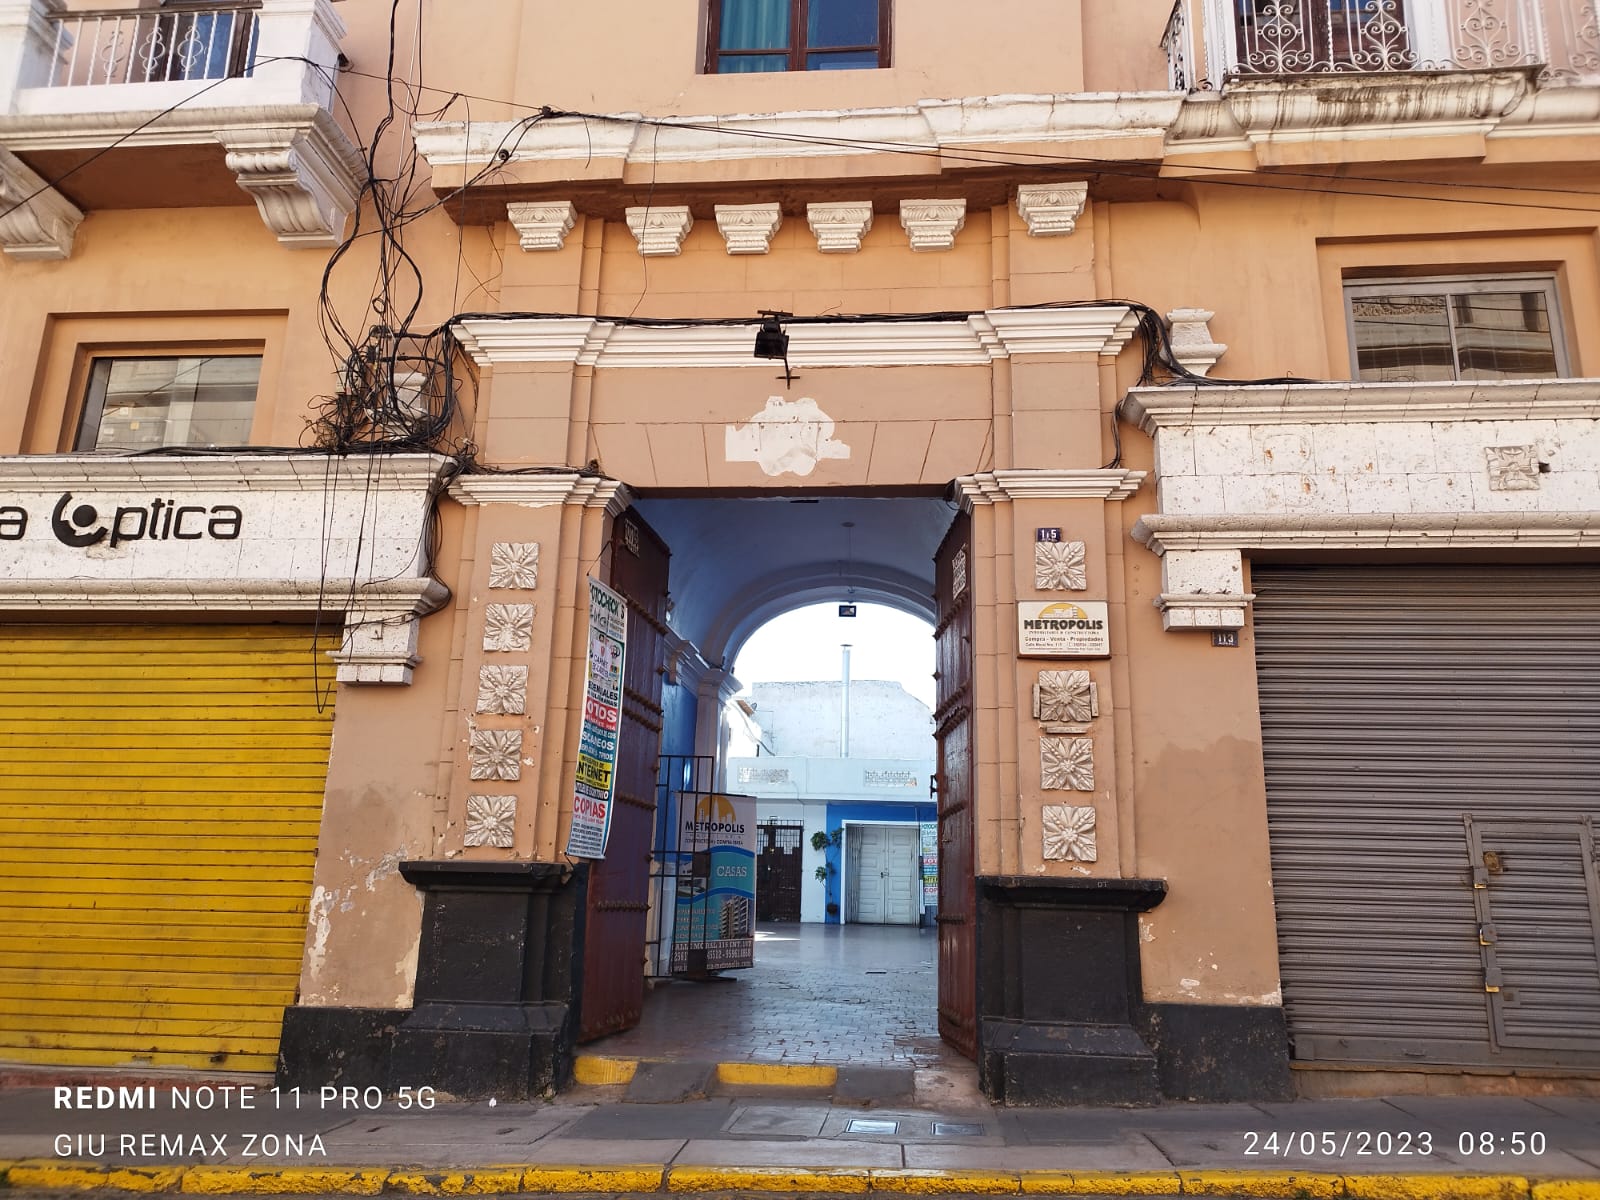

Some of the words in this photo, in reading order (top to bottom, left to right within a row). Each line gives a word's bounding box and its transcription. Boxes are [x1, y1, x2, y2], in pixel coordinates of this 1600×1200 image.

[1024, 619, 1103, 630] METROPOLIS
[1218, 633, 1234, 643] 113
[573, 796, 606, 819] COPIAS
[685, 821, 745, 834] METROPOLIS
[716, 864, 748, 877] CASAS
